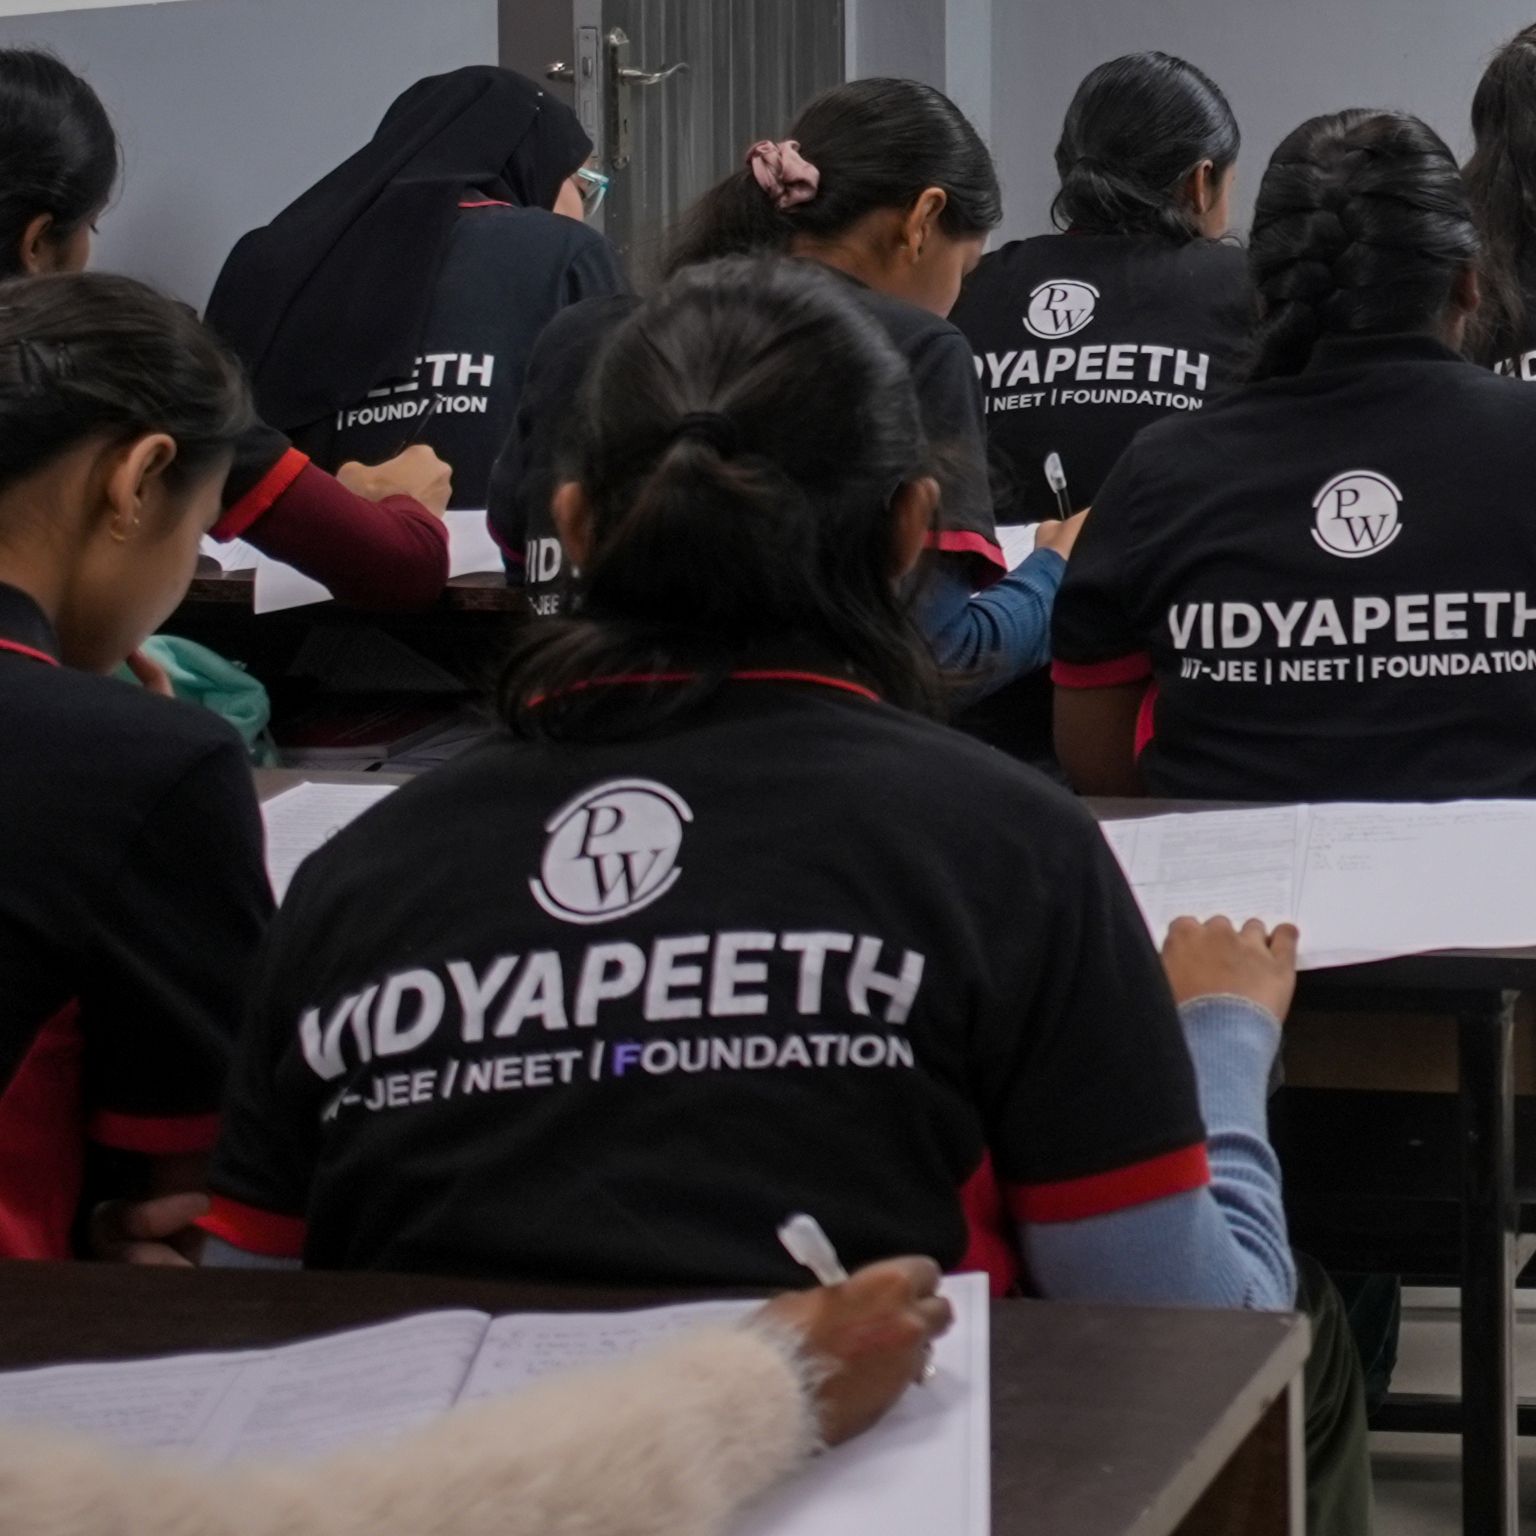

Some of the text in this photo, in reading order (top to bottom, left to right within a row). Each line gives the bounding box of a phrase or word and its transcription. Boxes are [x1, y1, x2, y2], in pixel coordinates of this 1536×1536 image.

[993, 392, 1046, 412] NEET
[1280, 658, 1350, 682] NEET
[298, 930, 926, 1082] VIDYAPEETH
[462, 1049, 583, 1094] NEET
[612, 1034, 915, 1078] FOUNDATION
